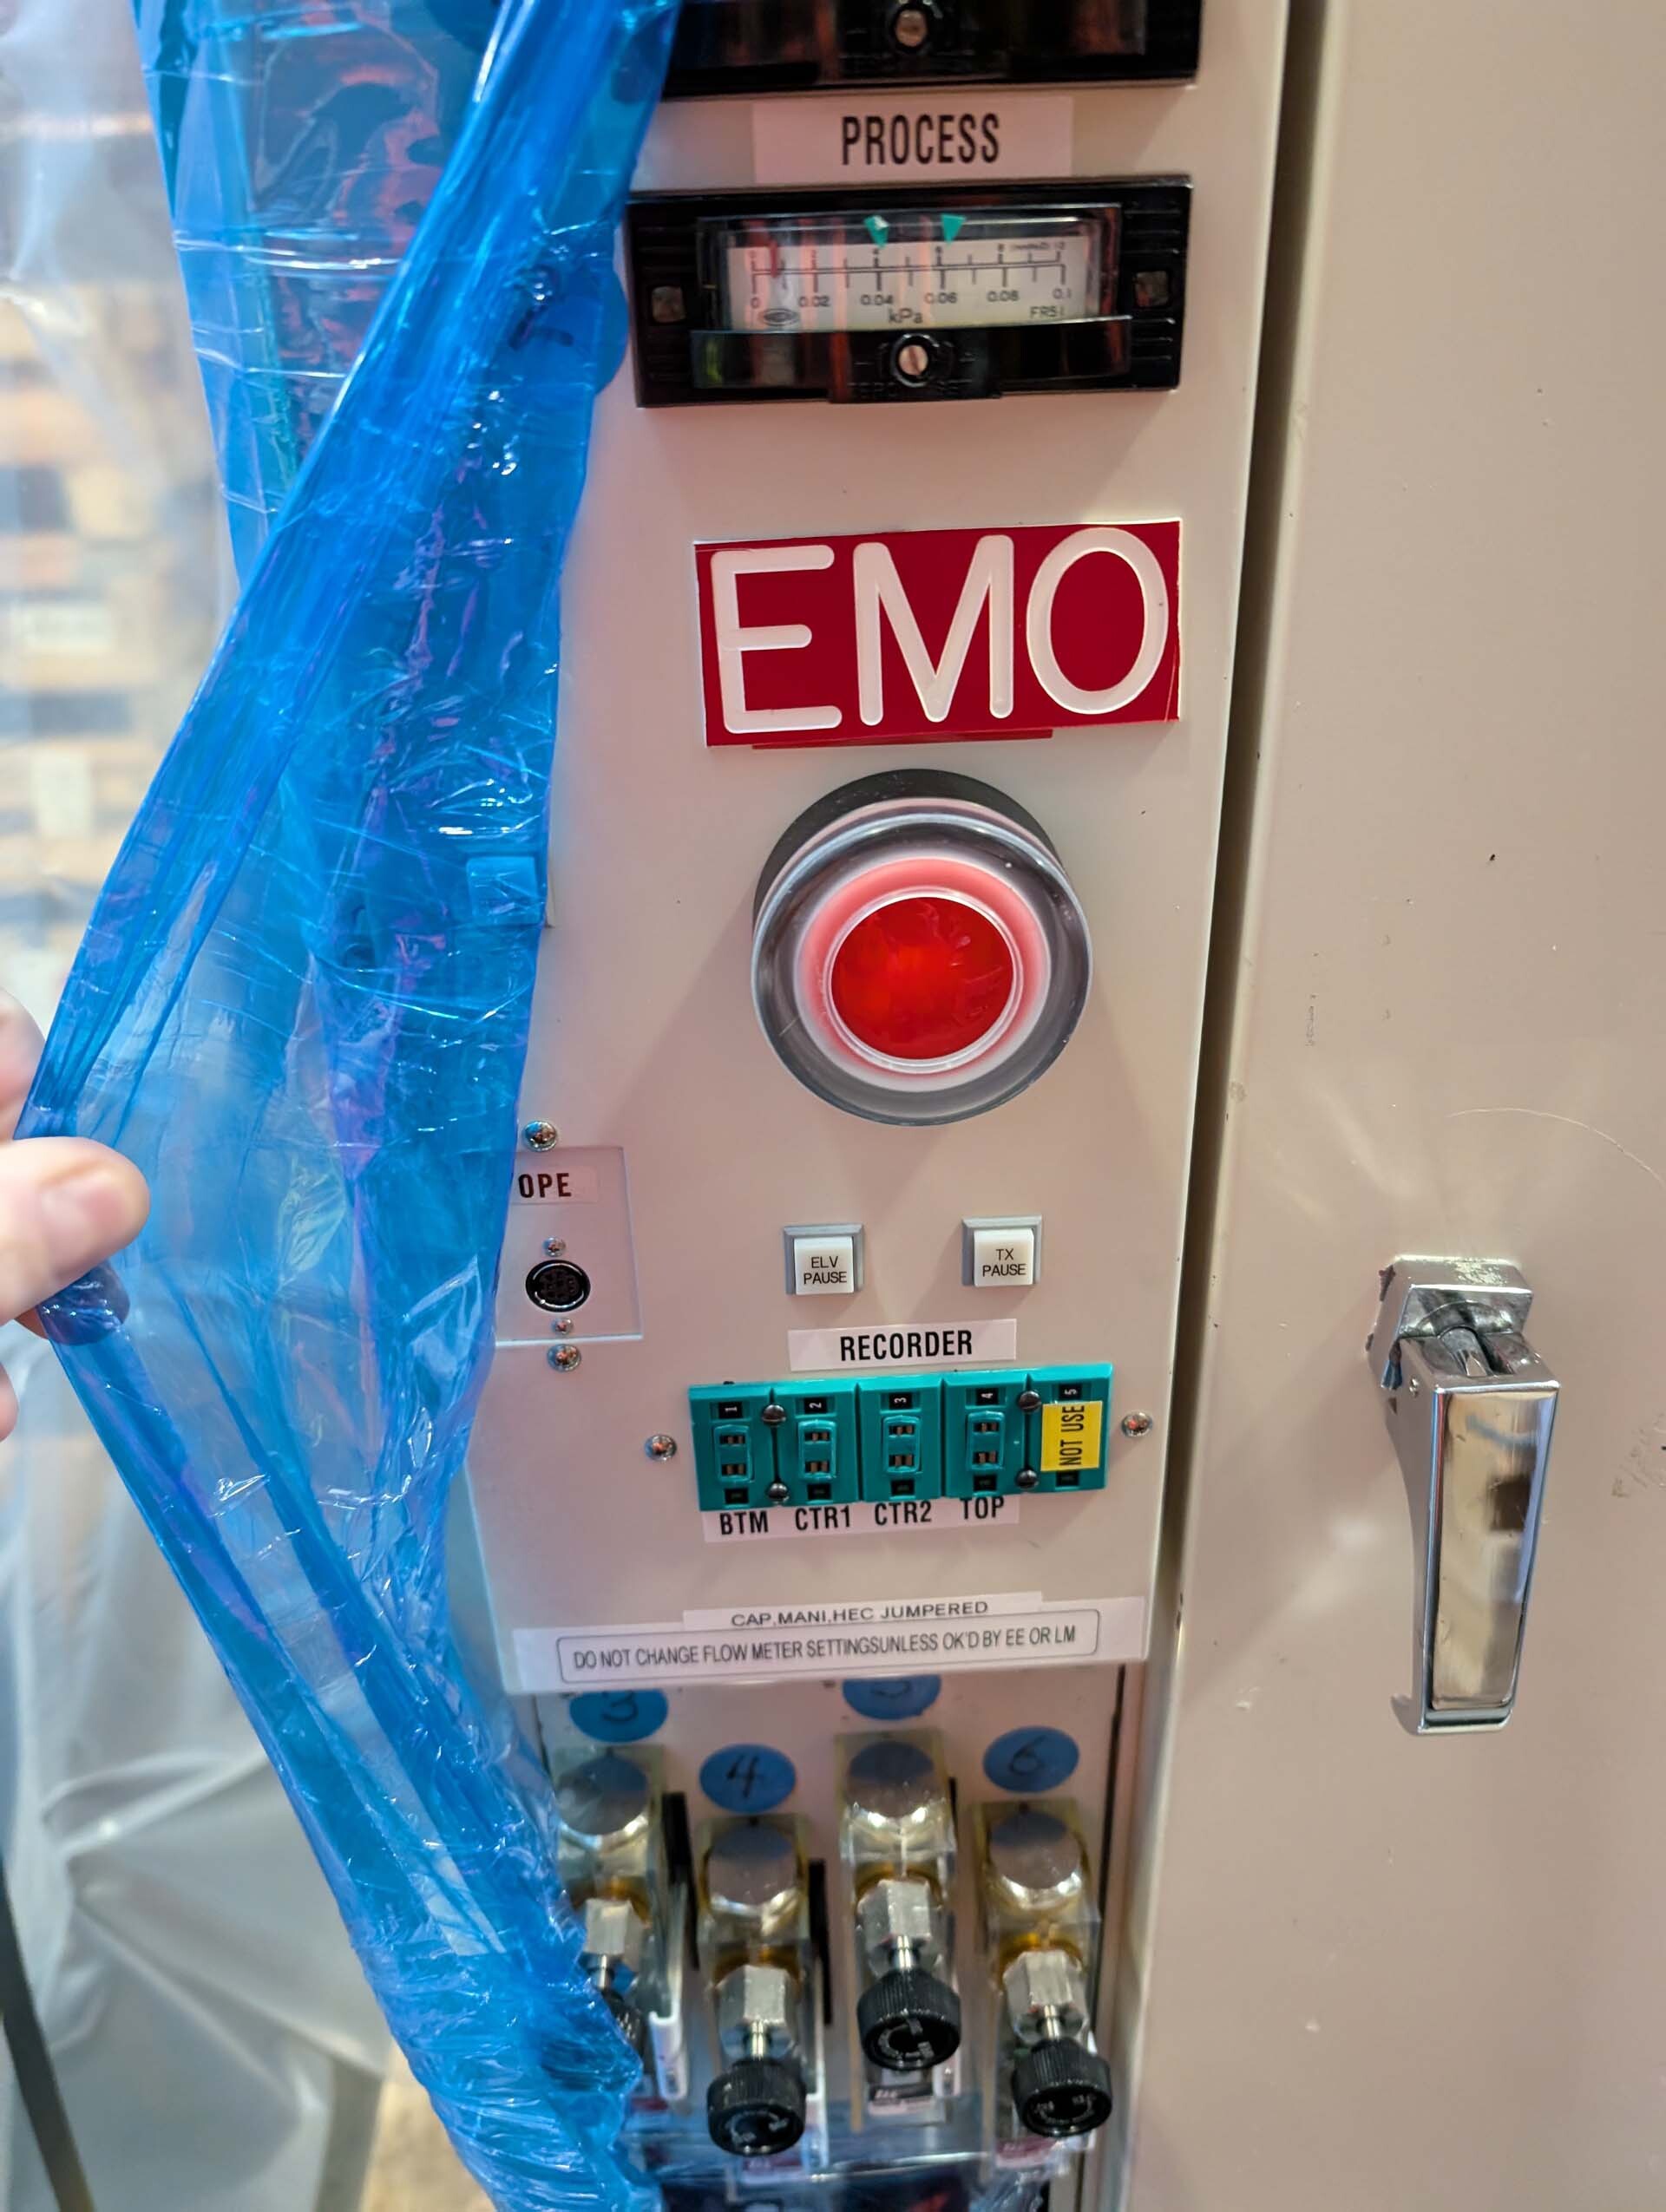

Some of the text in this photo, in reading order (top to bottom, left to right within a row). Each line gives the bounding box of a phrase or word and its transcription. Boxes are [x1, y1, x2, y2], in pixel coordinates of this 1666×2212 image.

[841, 113, 1000, 166] PROCESS
[798, 295, 830, 308] 0.02
[860, 293, 894, 306] 0.04
[888, 306, 924, 324] kPa
[710, 527, 1170, 735] EMO
[517, 1172, 573, 1199] OPE
[810, 1255, 839, 1269] ELV
[995, 1248, 1015, 1261] TX
[803, 1270, 848, 1286] PAUSE
[981, 1263, 1027, 1278] PAUSE
[839, 1330, 973, 1362] RECORDER
[809, 1401, 823, 1410] 2
[893, 1396, 908, 1404] 3
[981, 1391, 994, 1400] 4
[1060, 1404, 1086, 1433] USE
[1059, 1439, 1084, 1467] NOT
[795, 1505, 851, 1532] CTR1
[874, 1500, 933, 1527] CTR2
[960, 1495, 1006, 1520] TOP
[719, 1509, 770, 1536] BTM
[880, 1600, 989, 1620] JUMPERED
[574, 1624, 1076, 1669] DO NOT CHANGE FLOW METER SETTINGSUNLESS OK'D BY EE OR LM
[1009, 1736, 1046, 1776] 6
[726, 1754, 764, 1798] 4
